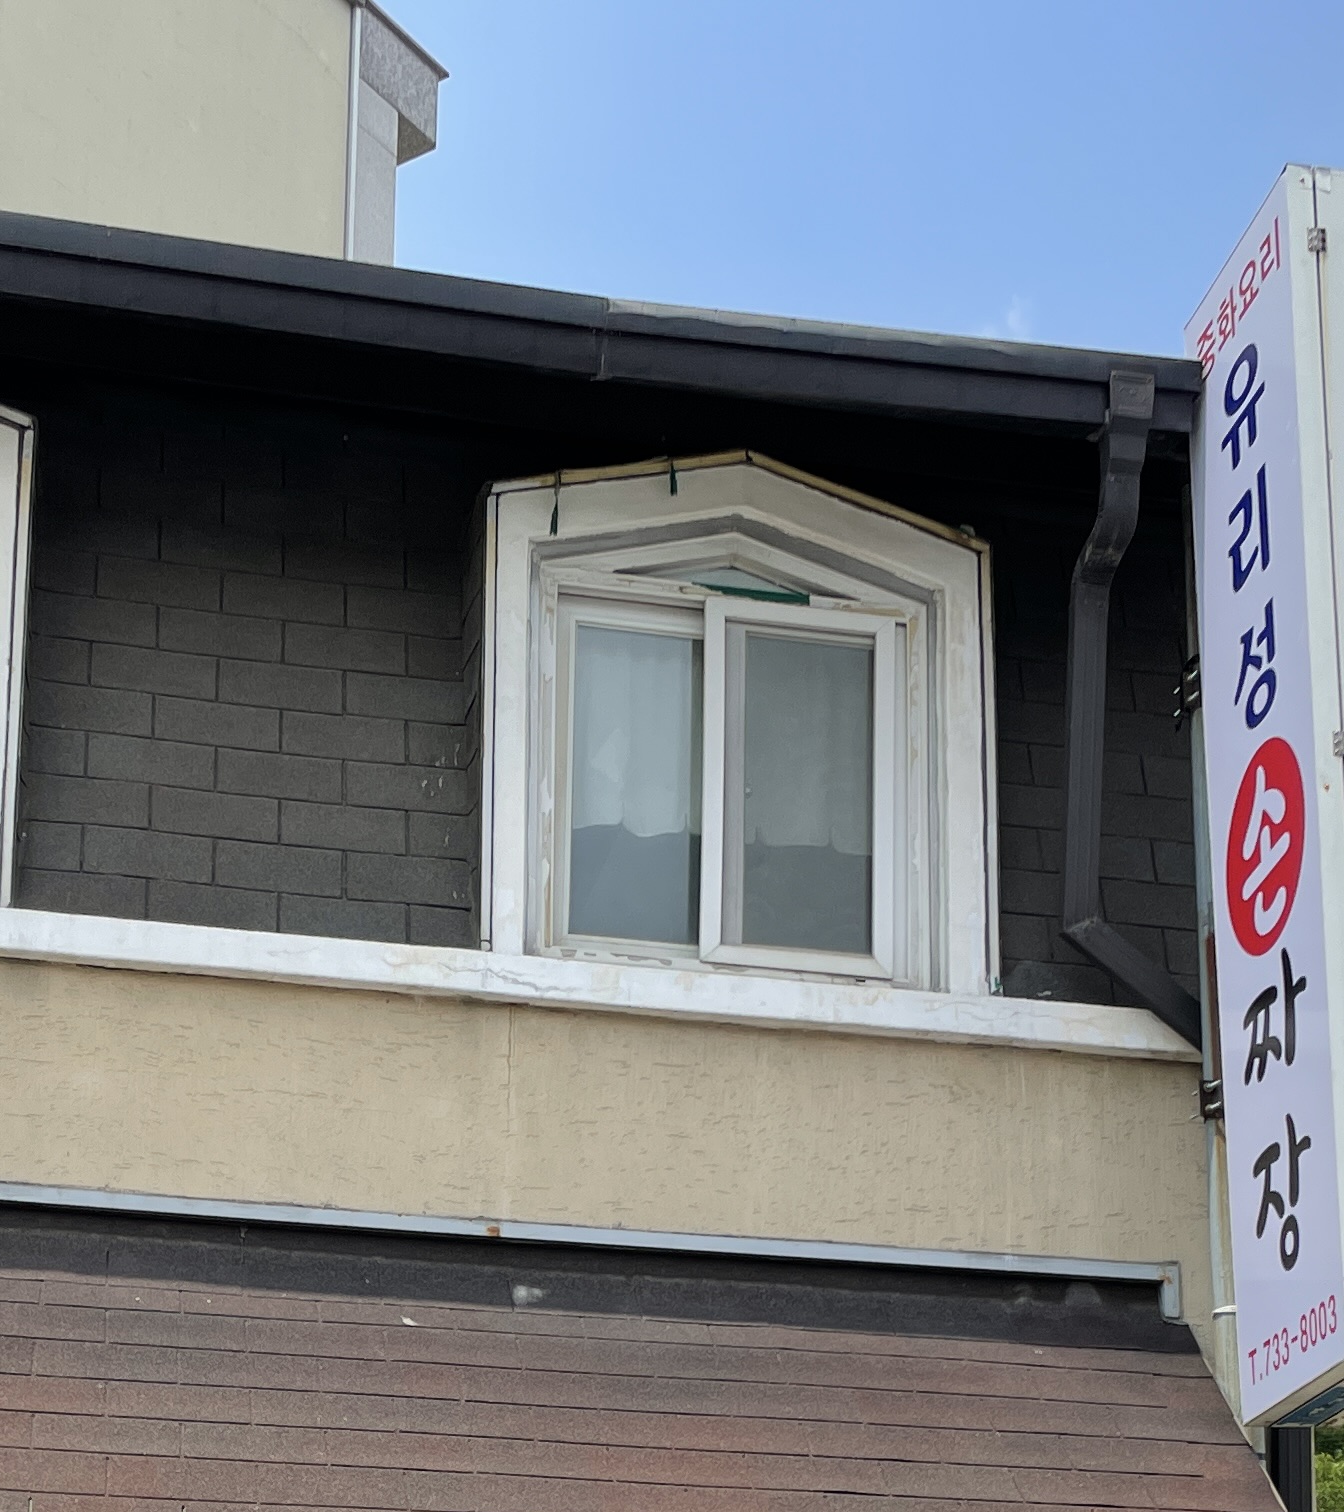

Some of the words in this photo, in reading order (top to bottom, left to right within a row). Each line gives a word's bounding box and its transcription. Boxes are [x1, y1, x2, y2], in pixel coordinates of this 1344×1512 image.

[1197, 215, 1281, 382] 중화요리
[1221, 342, 1278, 730] 유리성
[1242, 765, 1291, 937] 손
[1243, 946, 1312, 1272] 짜장
[1248, 1294, 1338, 1386] T.733-8003
